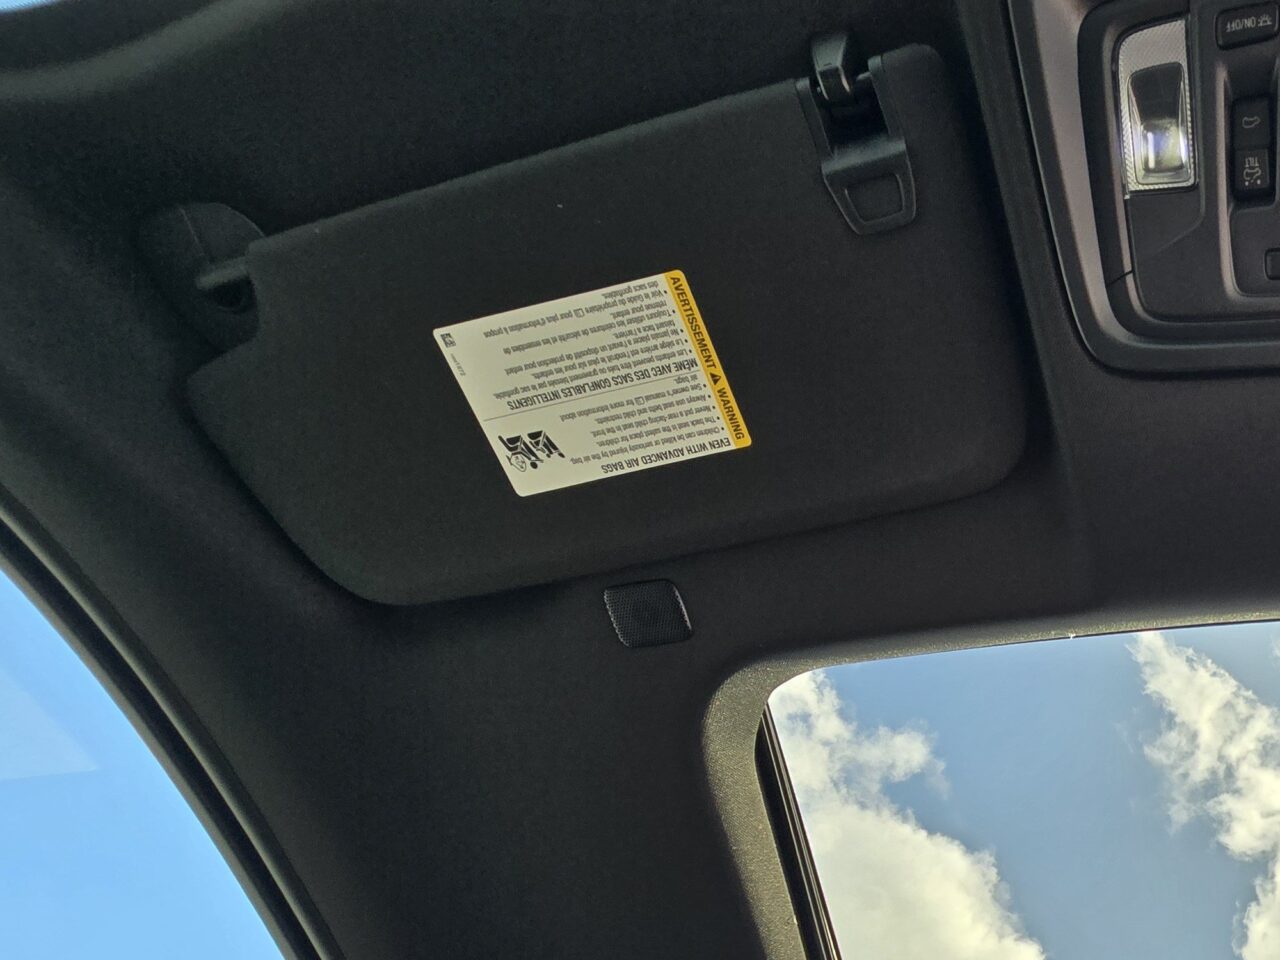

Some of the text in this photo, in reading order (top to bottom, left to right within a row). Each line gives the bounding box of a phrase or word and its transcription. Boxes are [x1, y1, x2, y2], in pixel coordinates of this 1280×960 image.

[1225, 15, 1257, 33] ON/OFF
[1244, 156, 1259, 167] TILT
[668, 275, 745, 440] WARNING AVERTISSEMENT
[505, 357, 698, 409] MÊME AVEC DES SACS GONFLABLES INTELLIGENTS
[599, 437, 731, 473] EVEN WITH ADVANCED AIR BAGS
